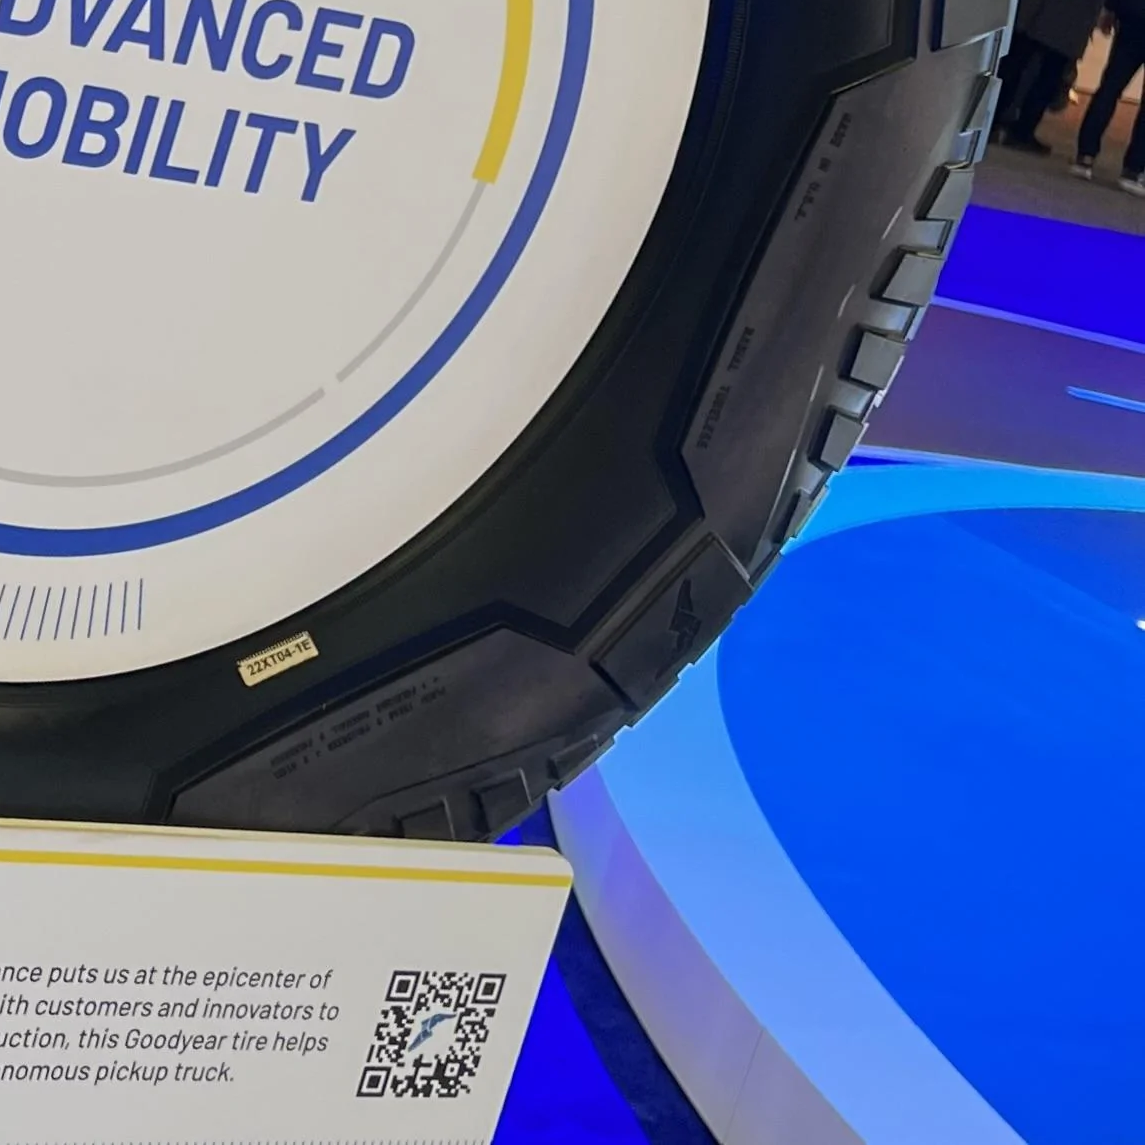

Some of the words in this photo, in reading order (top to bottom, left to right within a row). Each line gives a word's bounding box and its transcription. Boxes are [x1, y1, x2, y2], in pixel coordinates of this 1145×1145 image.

[247, 638, 312, 676] 22XT04-1E
[47, 965, 98, 987] puts
[104, 969, 129, 983] us
[134, 967, 157, 984] at
[163, 966, 196, 985] the
[203, 967, 306, 990] epicenter
[310, 970, 333, 988] of
[36, 998, 153, 1016] customers
[158, 999, 199, 1017] and
[202, 999, 314, 1021] innovators
[320, 1003, 340, 1021] to
[79, 1029, 119, 1048] this
[125, 1029, 227, 1054] Goodyear
[233, 1031, 268, 1051] tire
[273, 1032, 328, 1055] helps
[95, 1061, 169, 1086] pickup
[175, 1062, 234, 1082] truck.
